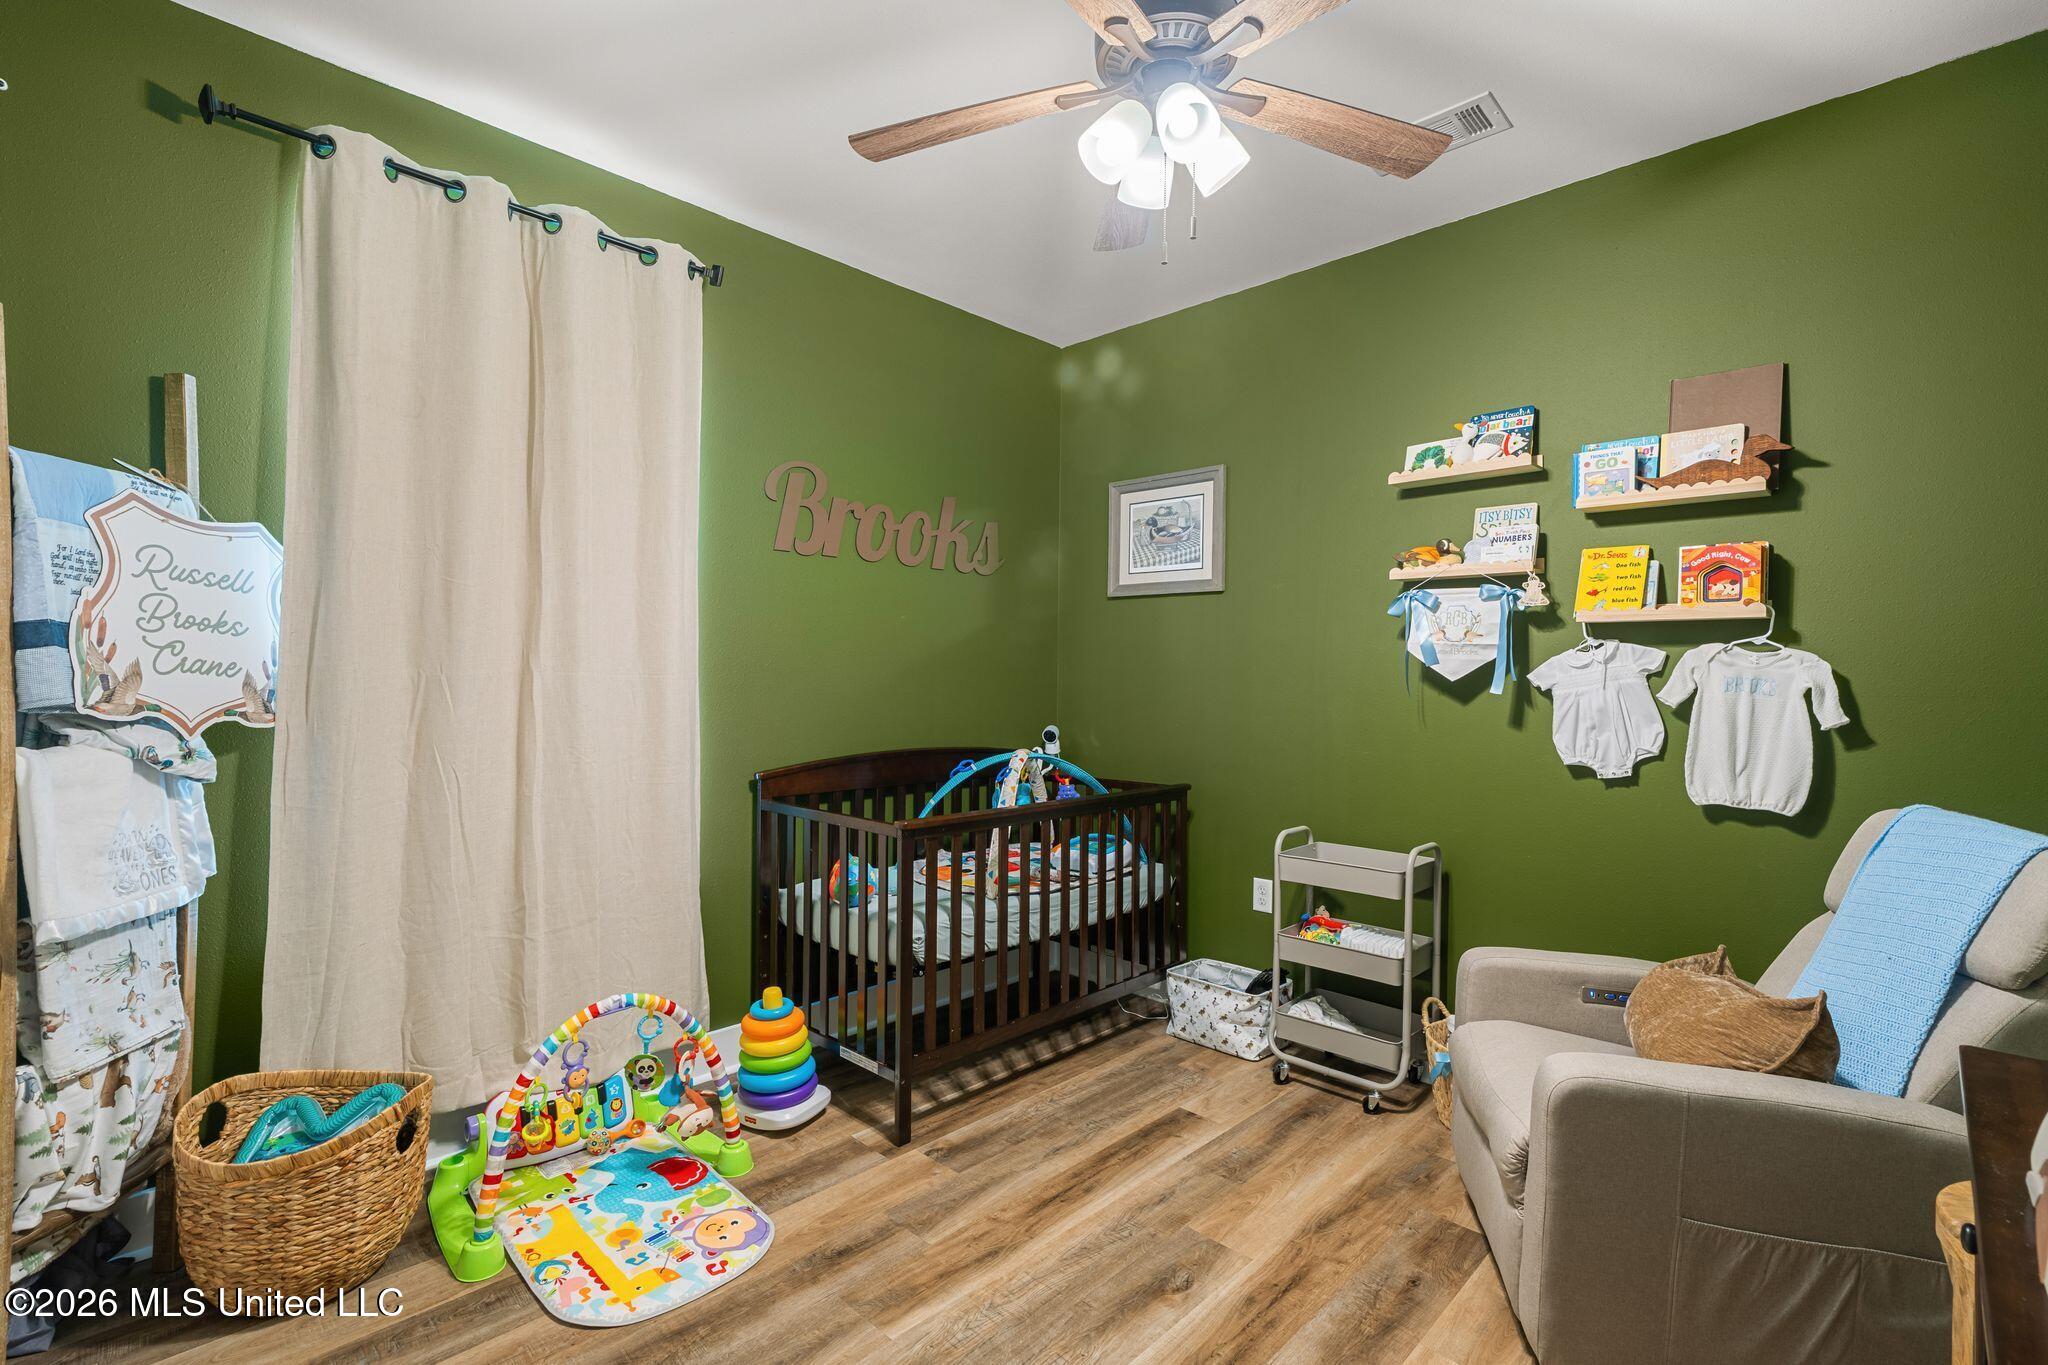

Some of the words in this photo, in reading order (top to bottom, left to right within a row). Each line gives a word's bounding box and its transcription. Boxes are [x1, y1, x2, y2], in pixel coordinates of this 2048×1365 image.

[1503, 416, 1532, 428] bear!
[1595, 457, 1618, 469] GO
[764, 460, 1005, 576] Brooks
[1479, 510, 1501, 523] ITSY
[1504, 507, 1532, 521] BITSY
[1492, 533, 1532, 543] NUMBERS
[1607, 551, 1628, 559] Seuss
[1691, 554, 1711, 567] Good
[1711, 550, 1733, 559] Night,
[1735, 553, 1752, 563] Cow
[132, 544, 254, 594] Russell
[136, 592, 249, 636] Brooks
[142, 635, 242, 678] Crane
[140, 865, 178, 891] ONES
